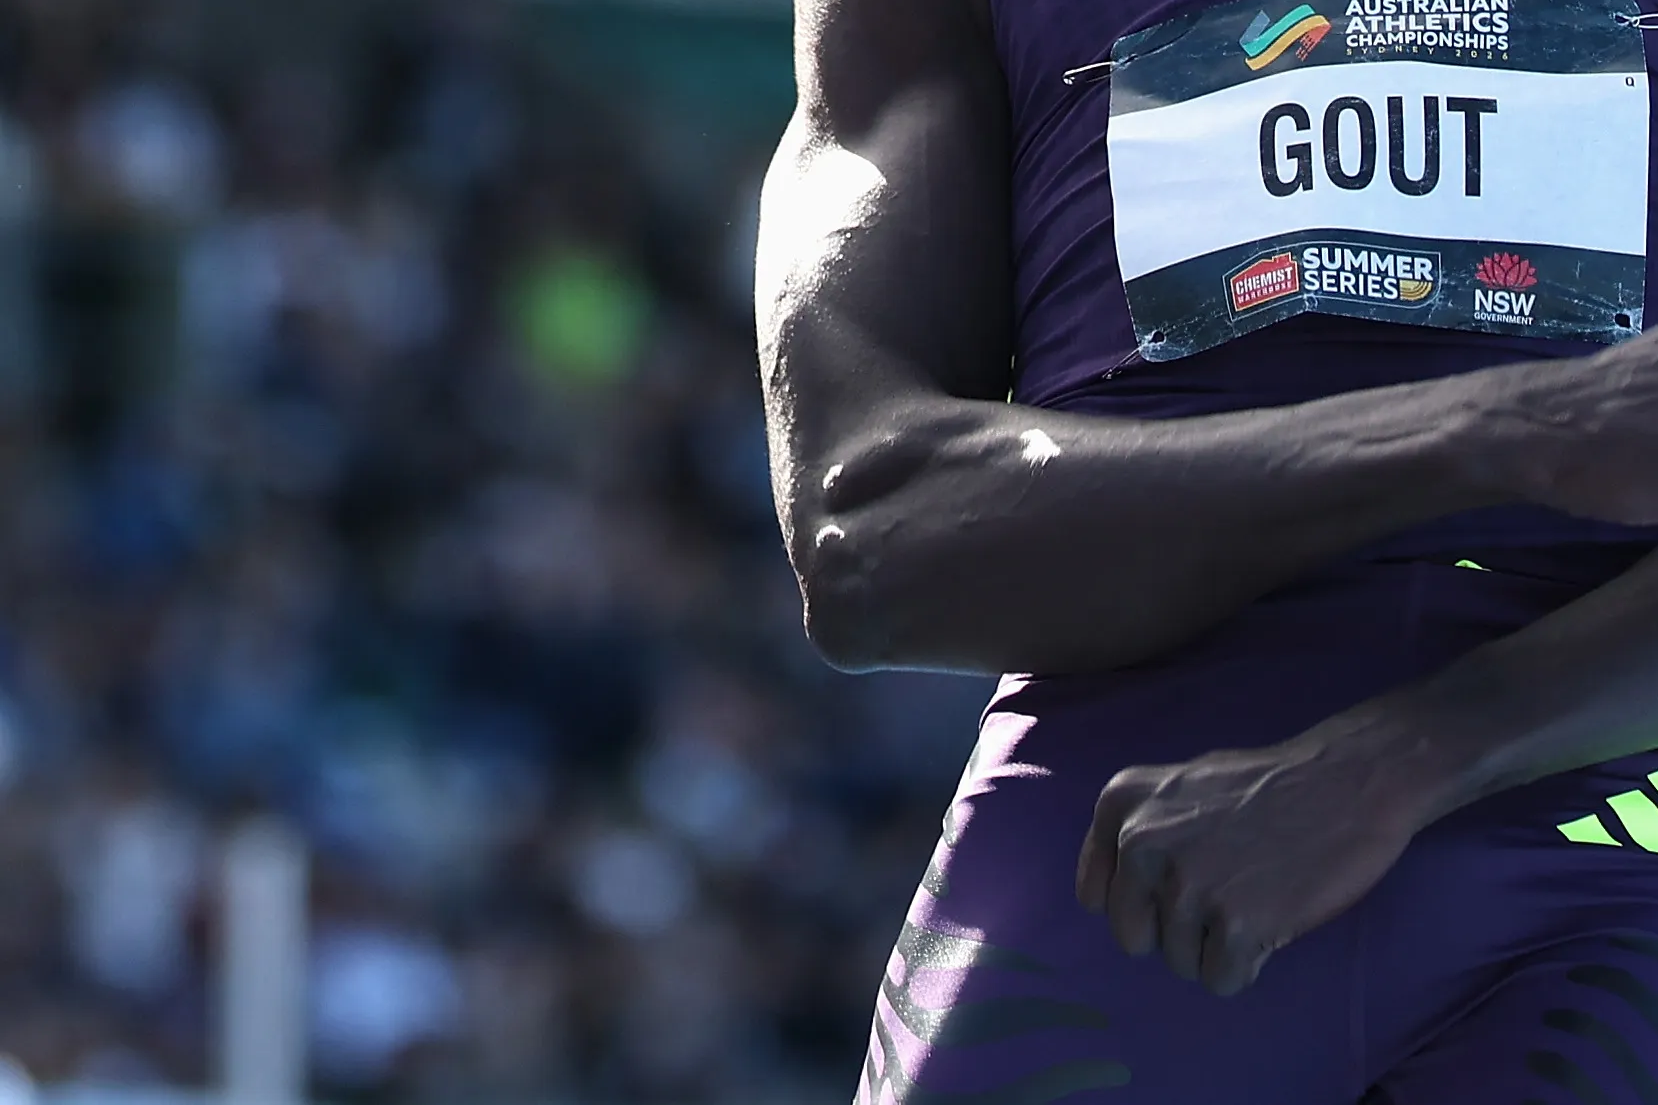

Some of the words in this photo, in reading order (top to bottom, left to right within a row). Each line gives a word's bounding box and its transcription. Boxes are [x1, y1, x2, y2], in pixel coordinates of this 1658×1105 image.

[1345, 12, 1509, 34] ATHLETICS
[1346, 31, 1509, 51] CHAMPIONSHIPS
[1346, 46, 1434, 56] SYDNEY
[1455, 49, 1508, 60] 2026
[1259, 95, 1498, 198] GOUT
[1303, 247, 1434, 281] SUMMER
[1235, 266, 1293, 295] CHEMIST
[1303, 270, 1398, 300] SERIES
[1474, 288, 1536, 316] NSW
[1474, 311, 1534, 325] GOVERNMENT
